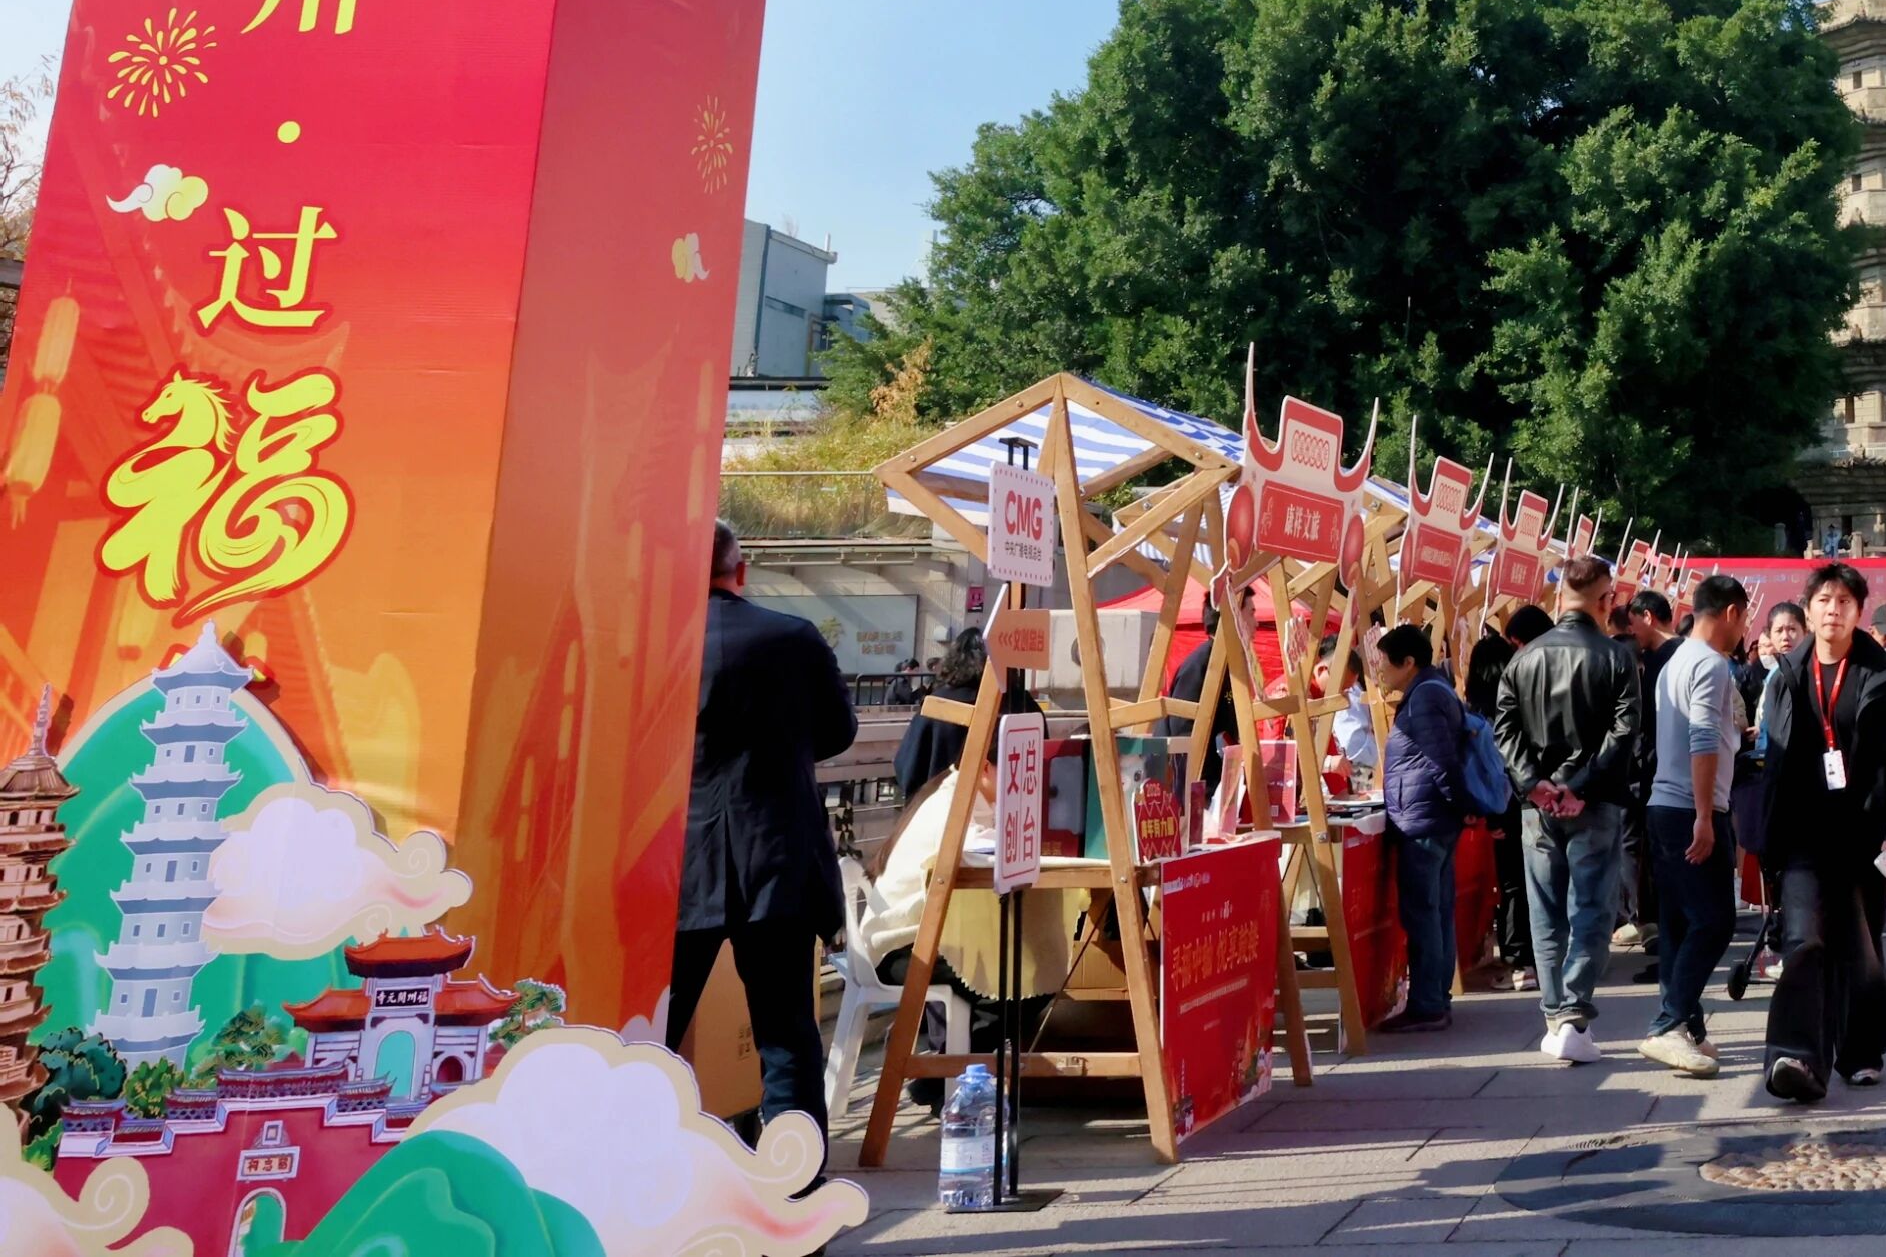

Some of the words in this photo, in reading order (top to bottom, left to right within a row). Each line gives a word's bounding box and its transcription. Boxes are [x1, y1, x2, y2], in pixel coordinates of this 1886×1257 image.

[1005, 490, 1043, 541] CMG
[1005, 746, 1021, 864] 文创
[1023, 740, 1038, 861] 总台
